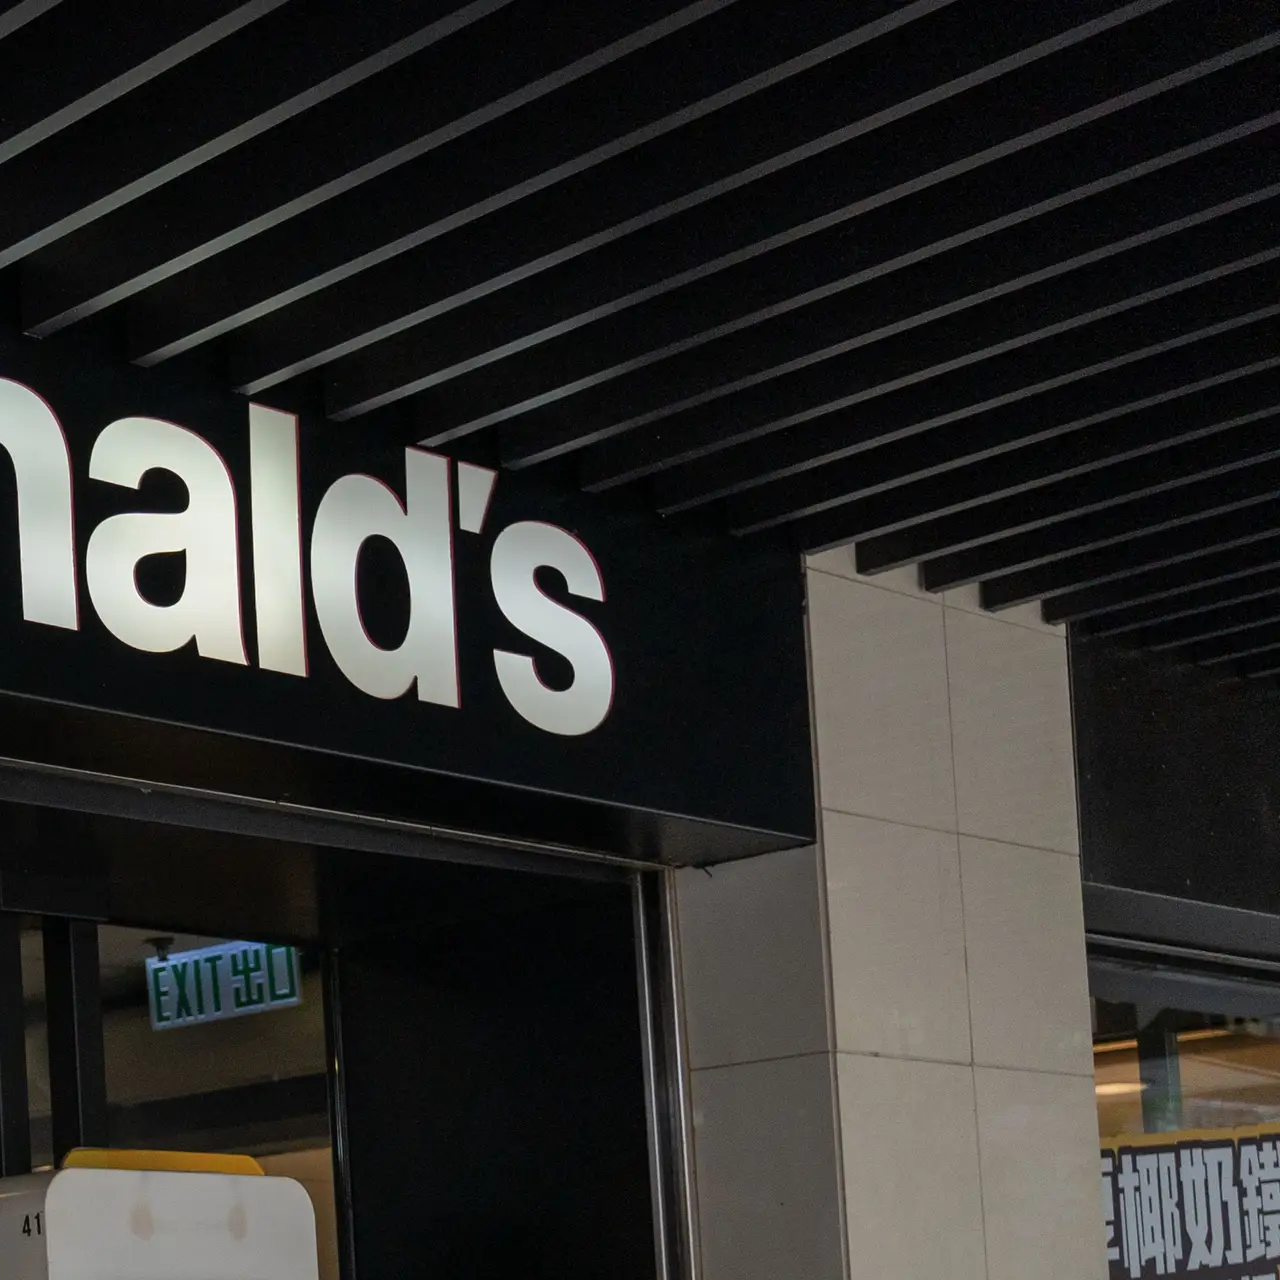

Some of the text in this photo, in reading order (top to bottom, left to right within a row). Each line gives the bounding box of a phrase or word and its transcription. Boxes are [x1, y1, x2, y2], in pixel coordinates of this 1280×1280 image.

[153, 945, 297, 1022] EXIT 出口
[22, 1213, 42, 1237] 41
